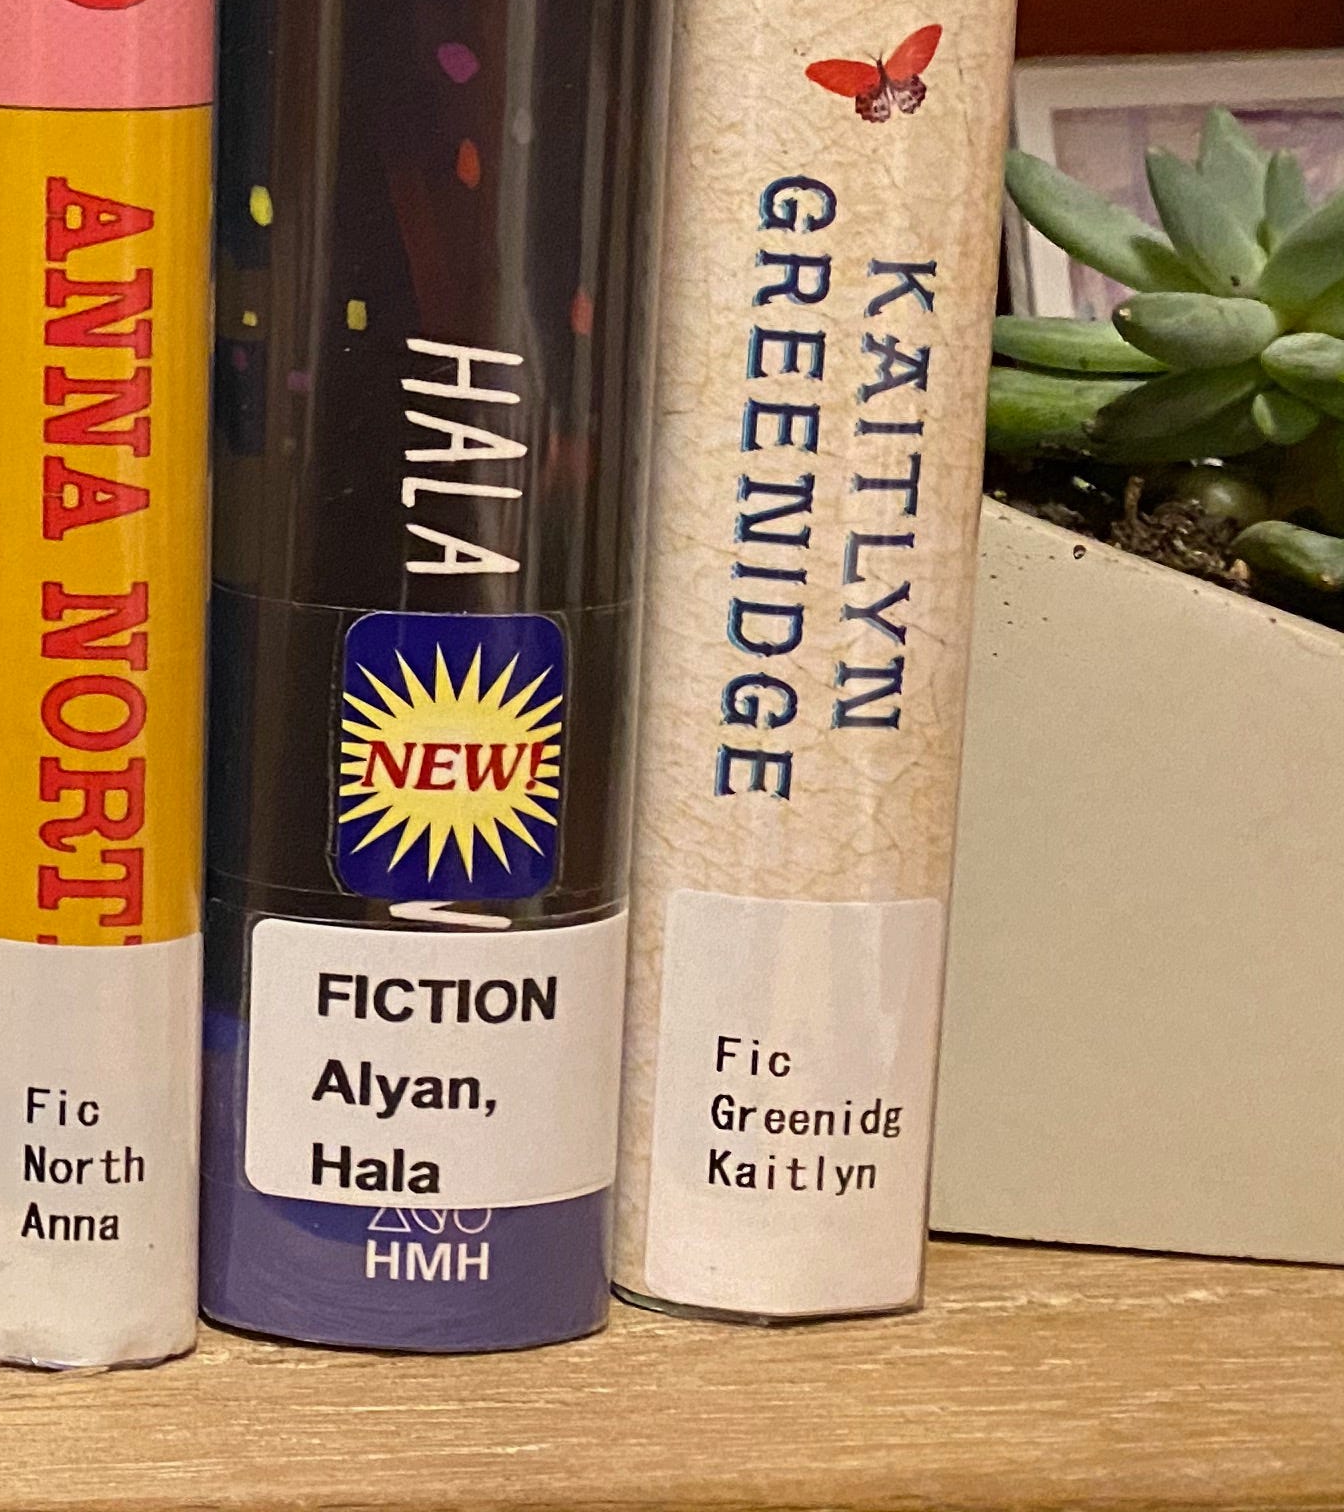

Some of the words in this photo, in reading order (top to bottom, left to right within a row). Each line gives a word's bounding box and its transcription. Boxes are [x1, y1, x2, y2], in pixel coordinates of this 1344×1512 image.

[42, 177, 155, 541] ANNA
[400, 337, 528, 575] HALA
[714, 174, 836, 803] GREENIDGE
[831, 257, 938, 732] KAITLYN
[37, 582, 149, 946] NORT
[362, 741, 546, 792] NEW!
[318, 973, 558, 1023] FICTION
[716, 1036, 790, 1078] Fic
[25, 1088, 100, 1127] Fic
[311, 1059, 498, 1119] Alyan,
[712, 1094, 902, 1138] Greenidg
[23, 1145, 145, 1186] North
[311, 1143, 442, 1194] Hala
[709, 1149, 876, 1193] Kaitlyn
[21, 1204, 120, 1242] Anna
[366, 1239, 489, 1281] HMH
